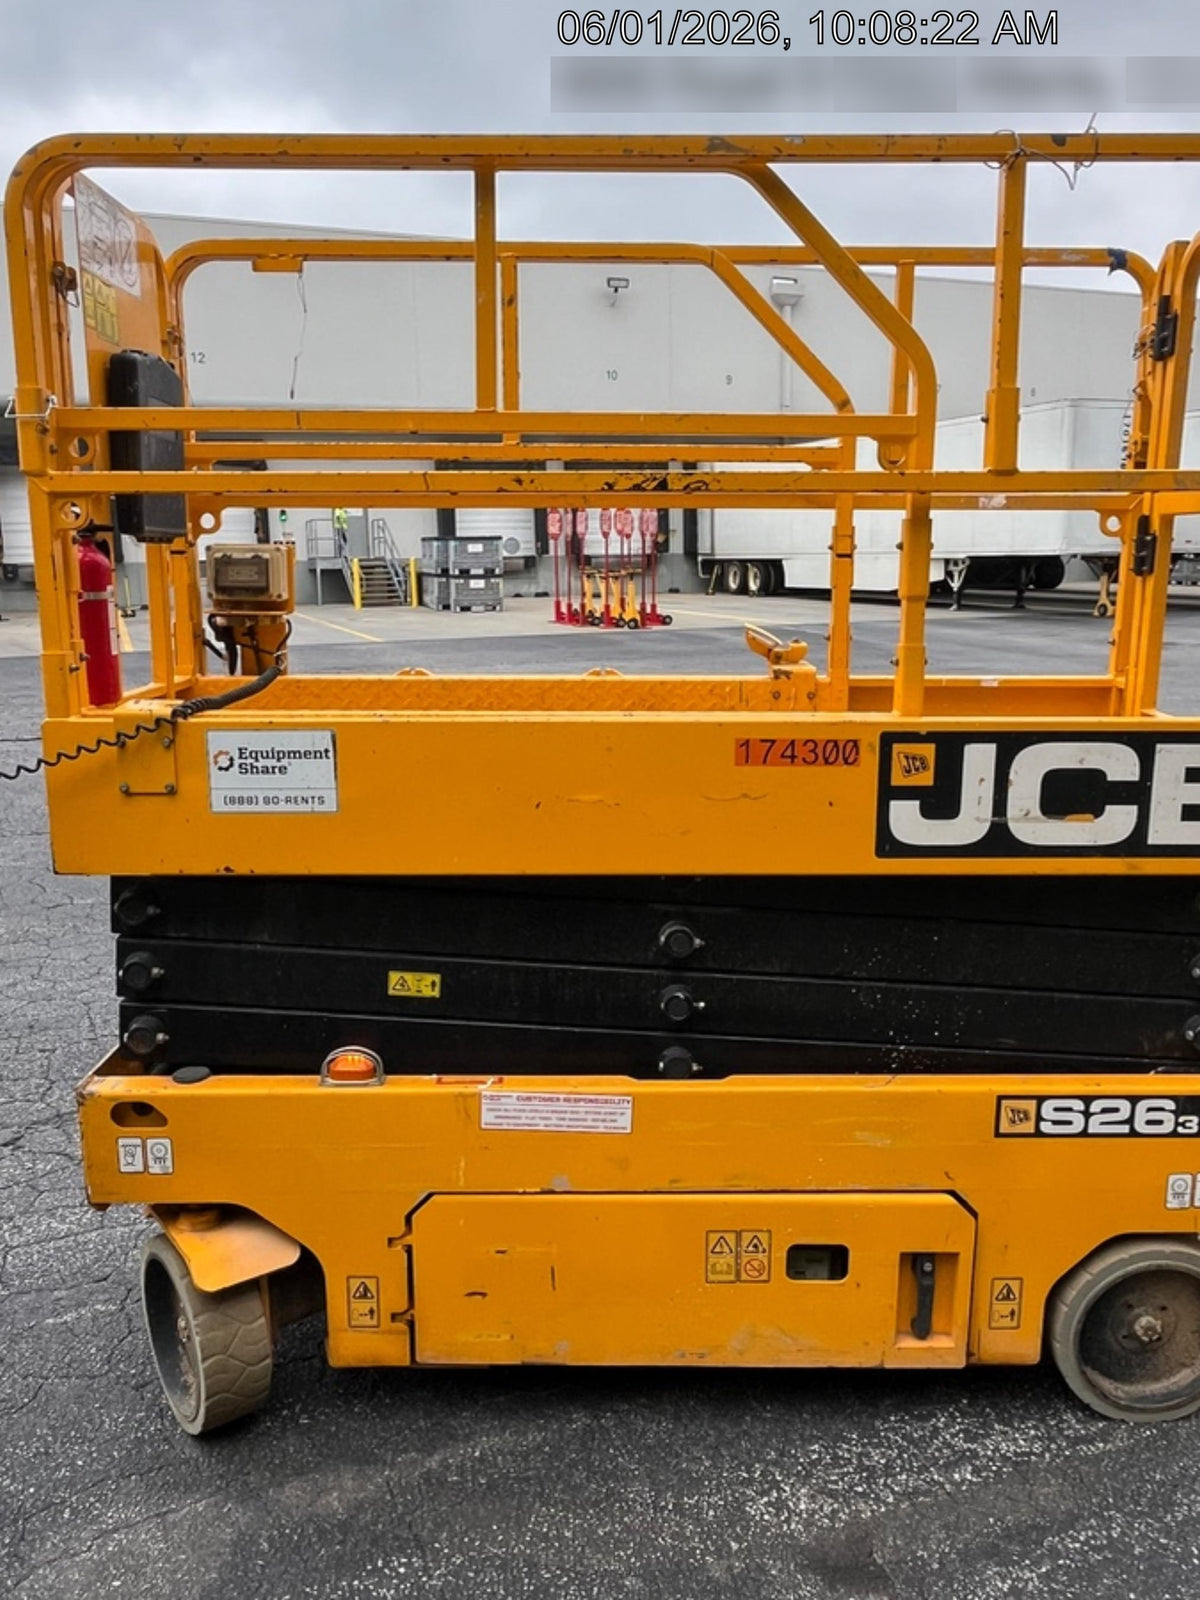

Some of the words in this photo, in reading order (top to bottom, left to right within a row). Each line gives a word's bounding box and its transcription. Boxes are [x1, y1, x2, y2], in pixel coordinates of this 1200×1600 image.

[190, 352, 206, 364] 12
[605, 369, 619, 382] 10
[237, 747, 331, 763] Equipment
[739, 739, 859, 766] 174300
[237, 762, 289, 776] Share
[902, 753, 929, 775] JCB
[223, 795, 259, 806] (888)
